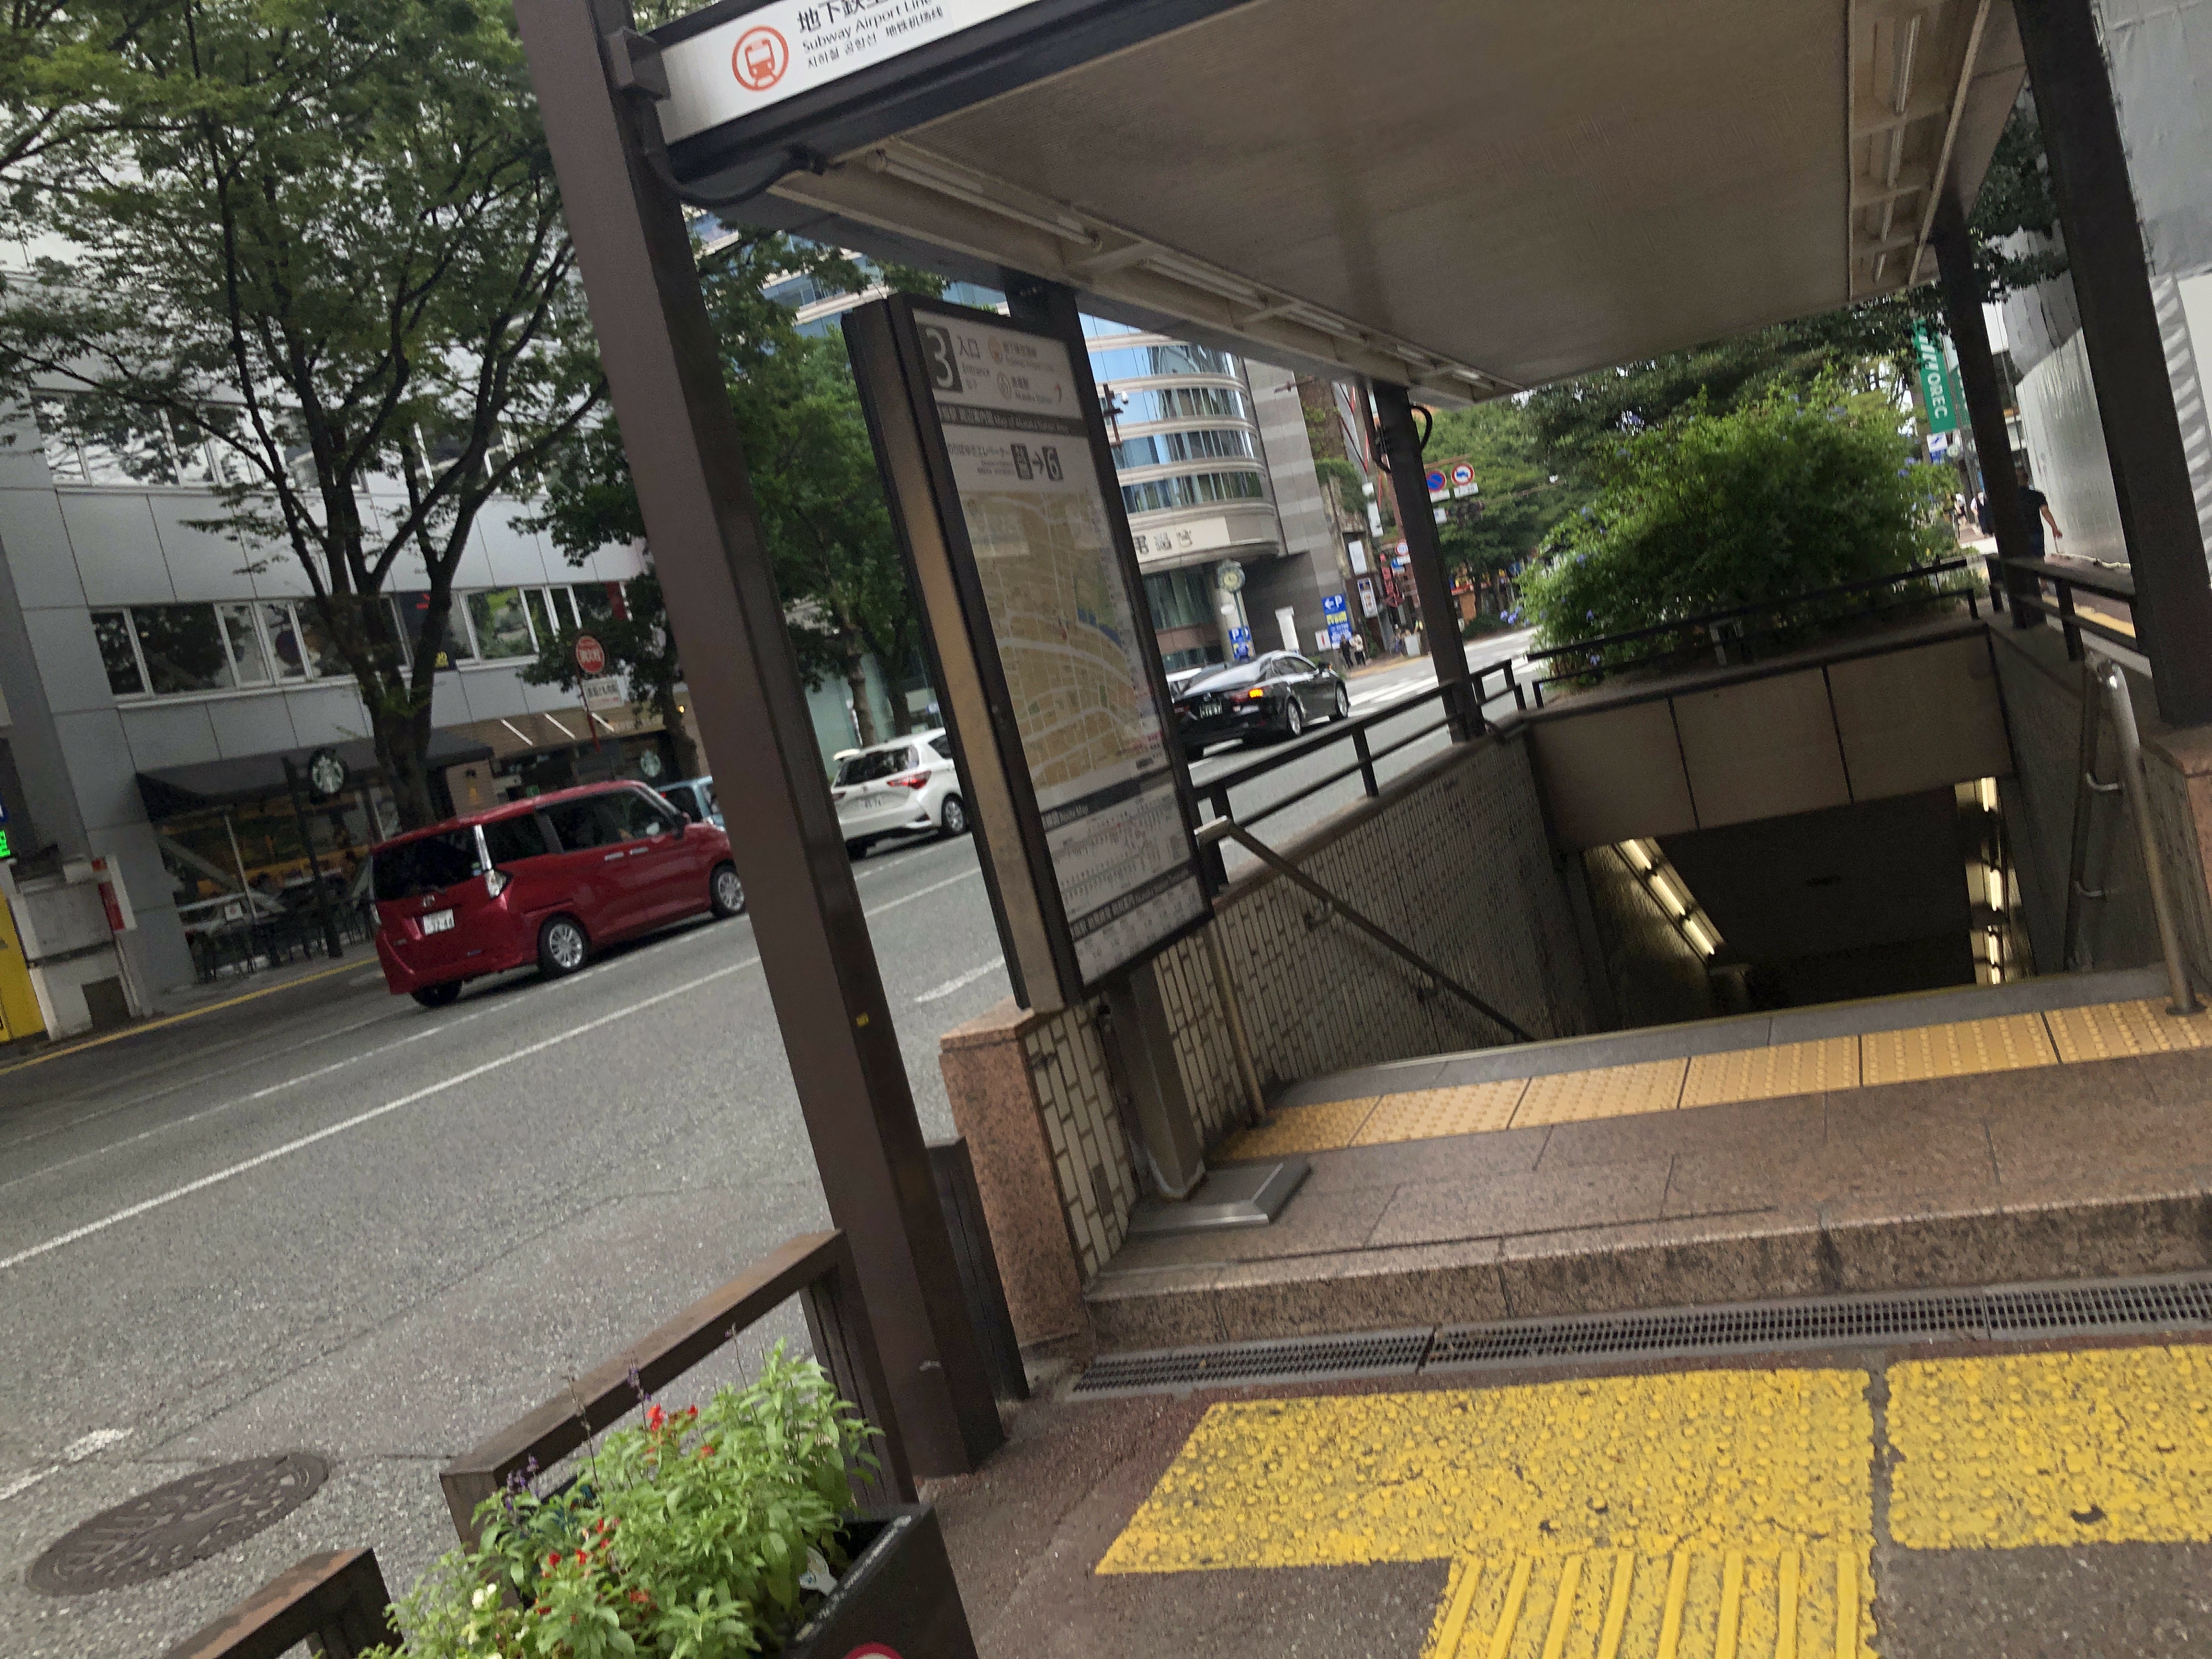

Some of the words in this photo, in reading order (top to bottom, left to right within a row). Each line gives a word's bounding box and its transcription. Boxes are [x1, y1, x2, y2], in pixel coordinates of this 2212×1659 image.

[803, 26, 851, 54] Subway
[856, 5, 901, 33] Airport
[926, 328, 953, 388] 3
[956, 335, 981, 359] 入口
[1927, 372, 1948, 420] OREC
[1334, 595, 1342, 608] P
